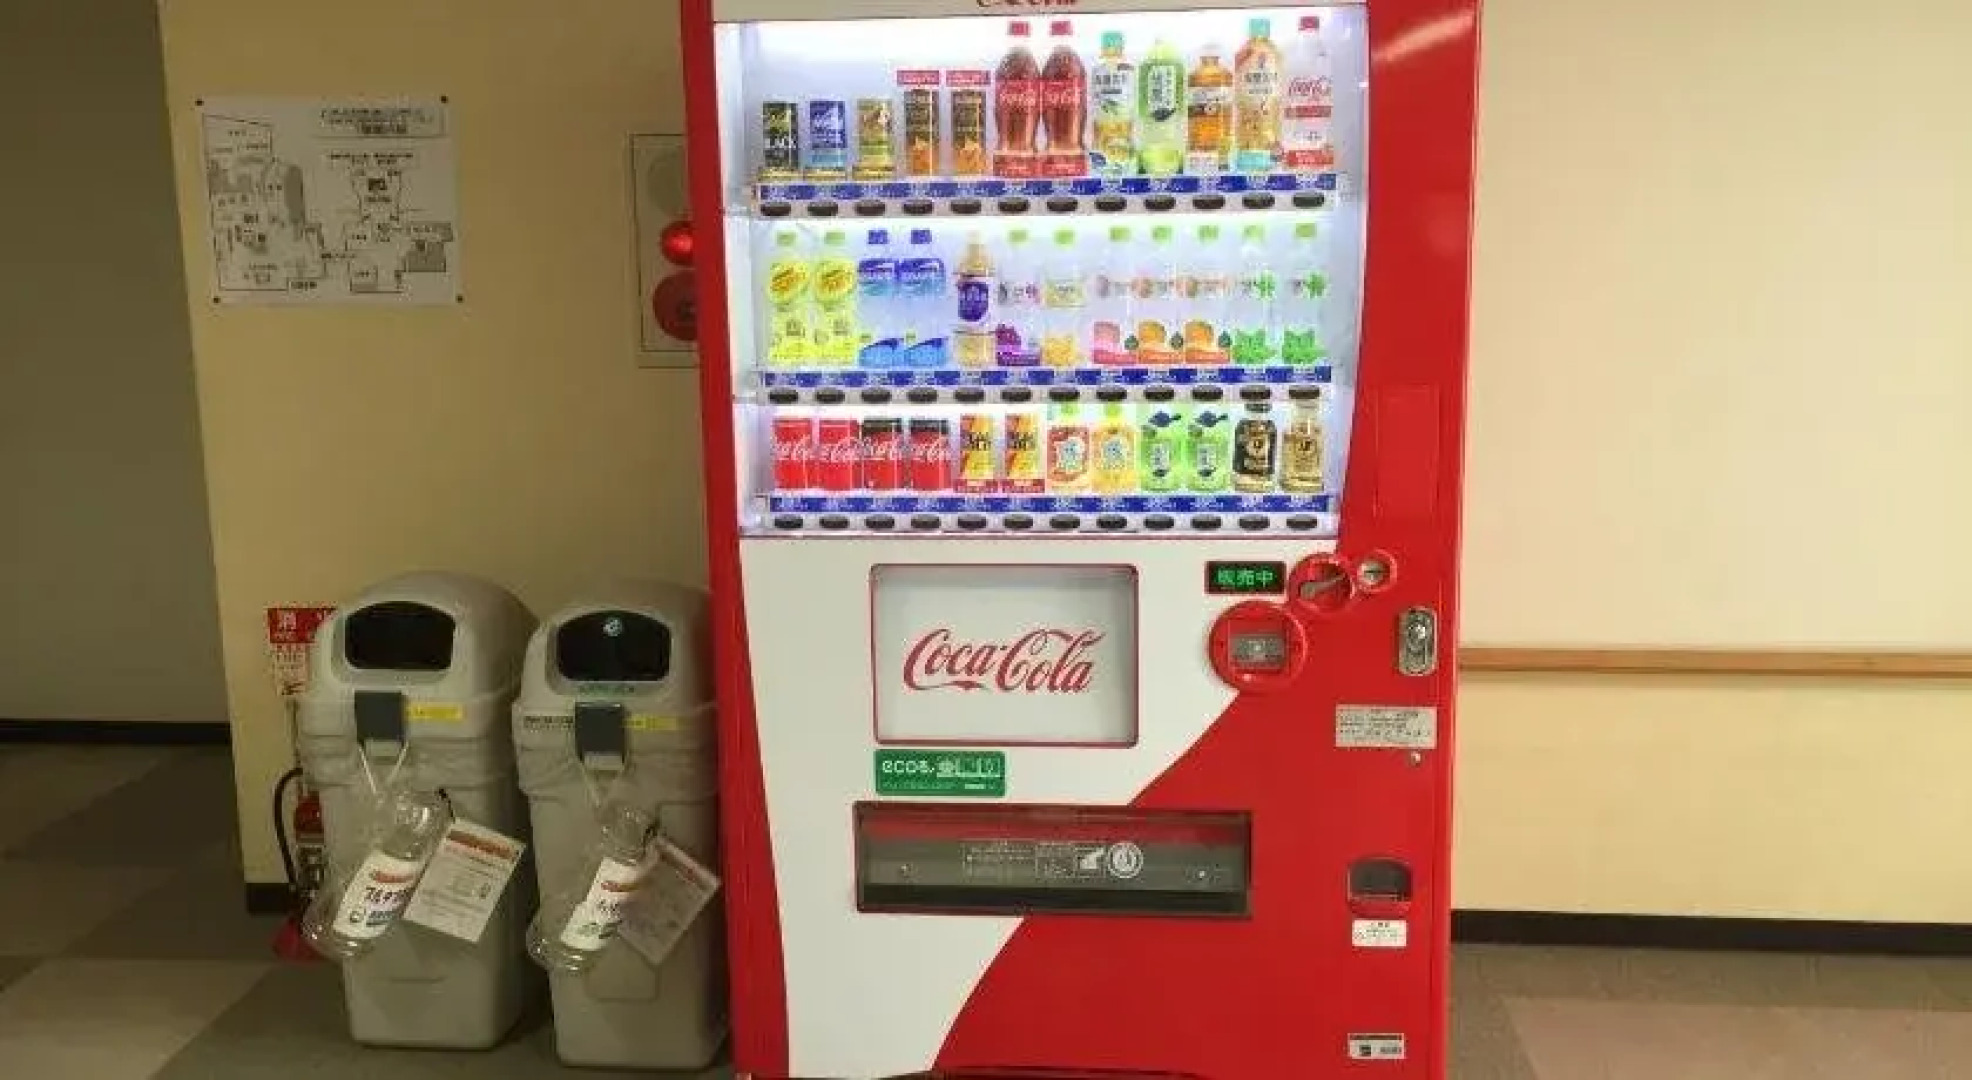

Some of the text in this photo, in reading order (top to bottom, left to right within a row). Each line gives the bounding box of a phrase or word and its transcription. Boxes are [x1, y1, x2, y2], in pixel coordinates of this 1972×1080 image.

[1216, 567, 1273, 588] 販売中
[904, 628, 1106, 693] Coca-Cola
